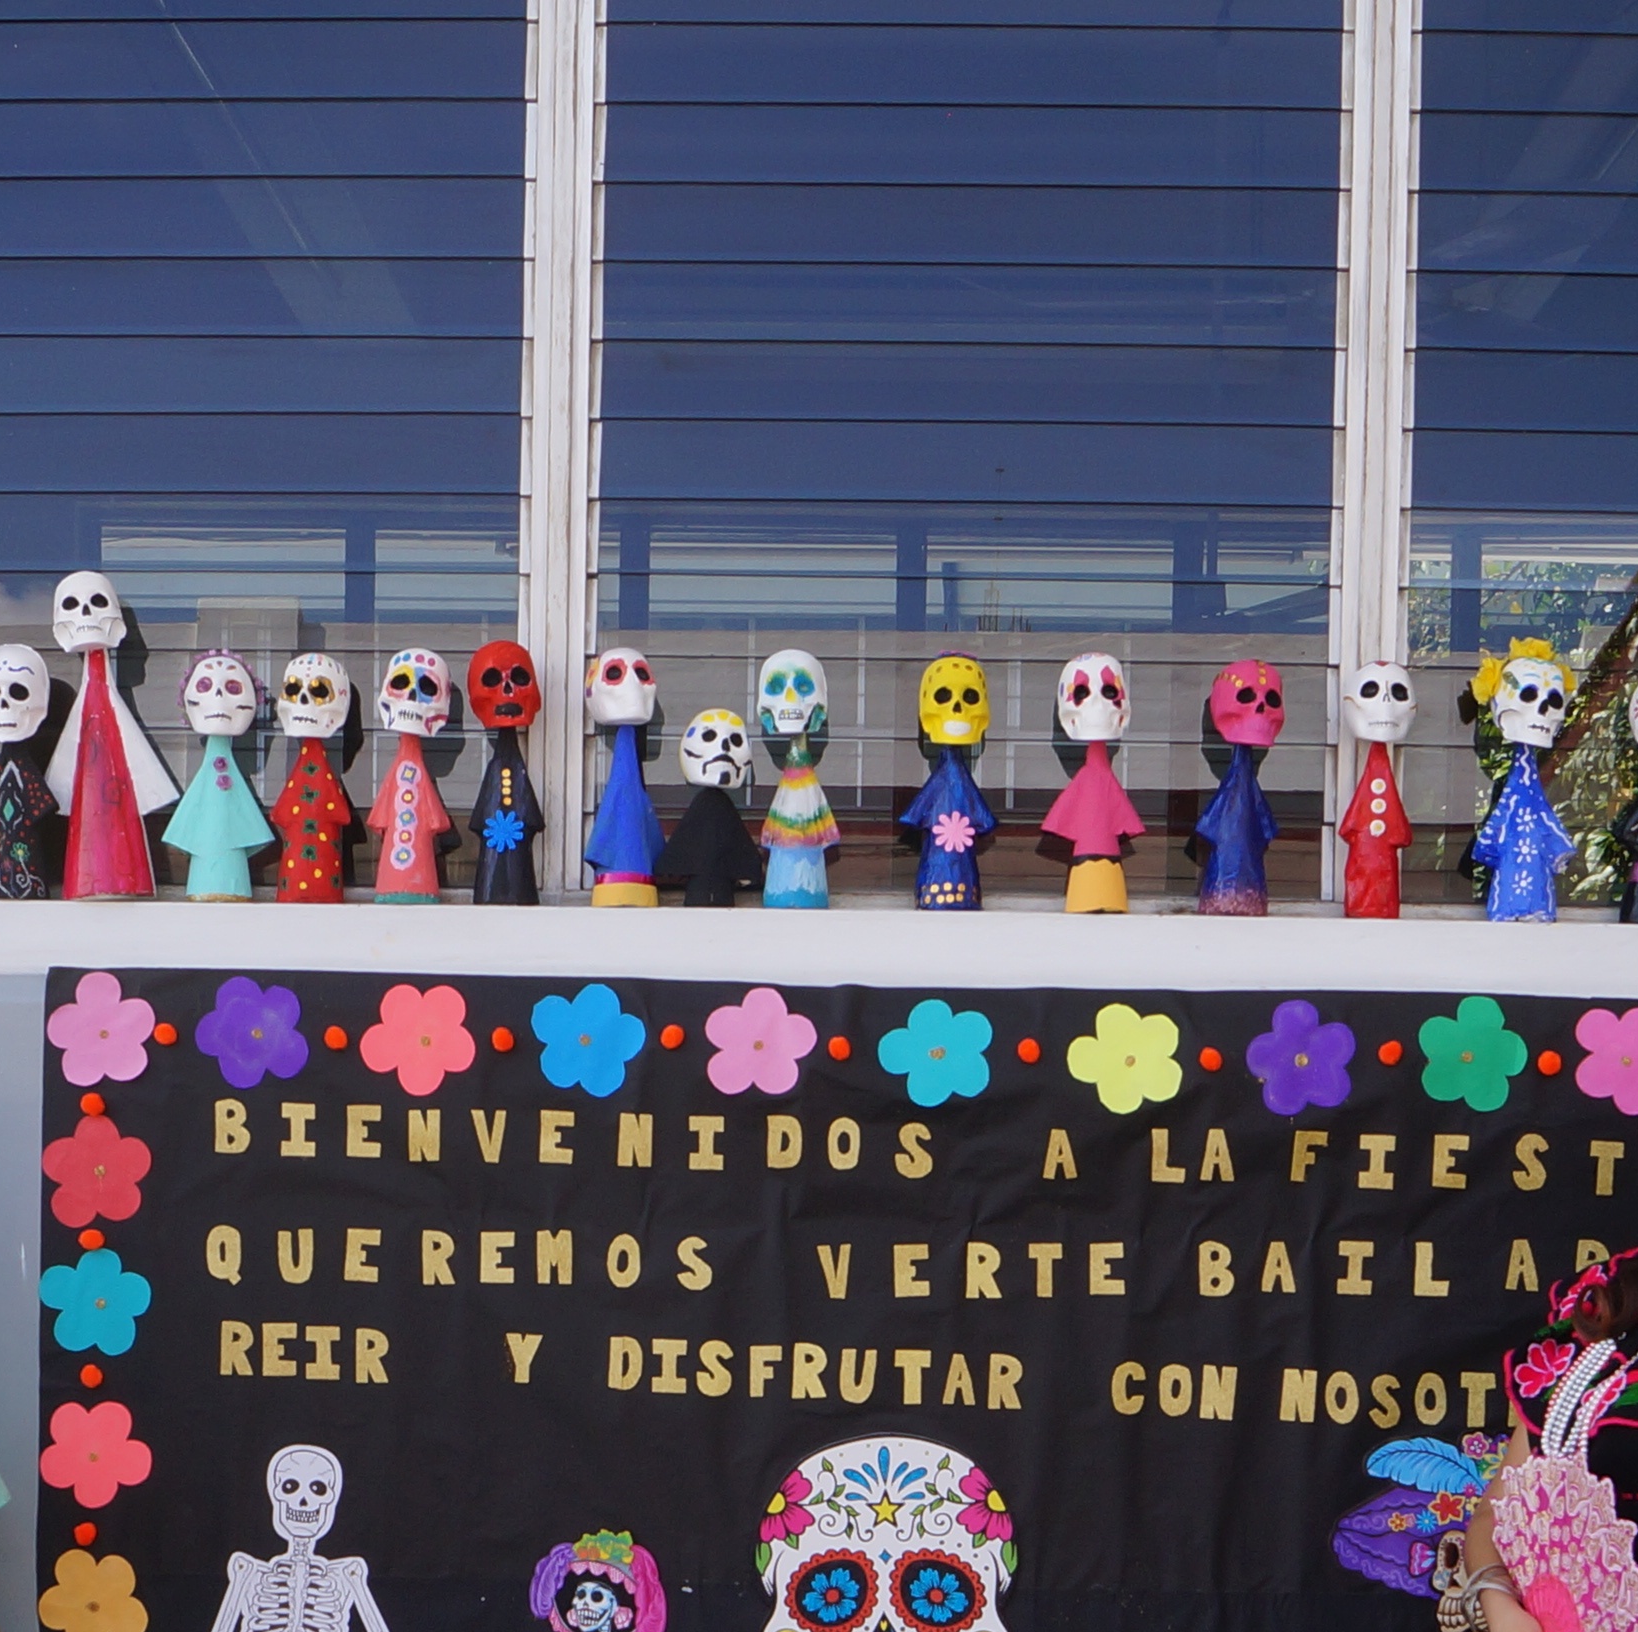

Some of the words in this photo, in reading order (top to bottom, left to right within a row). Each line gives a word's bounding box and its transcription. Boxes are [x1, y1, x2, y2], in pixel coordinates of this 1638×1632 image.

[213, 1098, 934, 1179] BIENVENIDOS
[1042, 1128, 1078, 1181] A
[1151, 1127, 1235, 1184] LA
[206, 1224, 713, 1291] QUEREMOS
[817, 1241, 1126, 1300] VERTE
[219, 1319, 390, 1384] REIR
[505, 1332, 544, 1384] Y
[607, 1335, 1024, 1411] DISFRUTAR
[1111, 1361, 1239, 1422] CON
[1277, 1368, 1523, 1430] NOSOT
